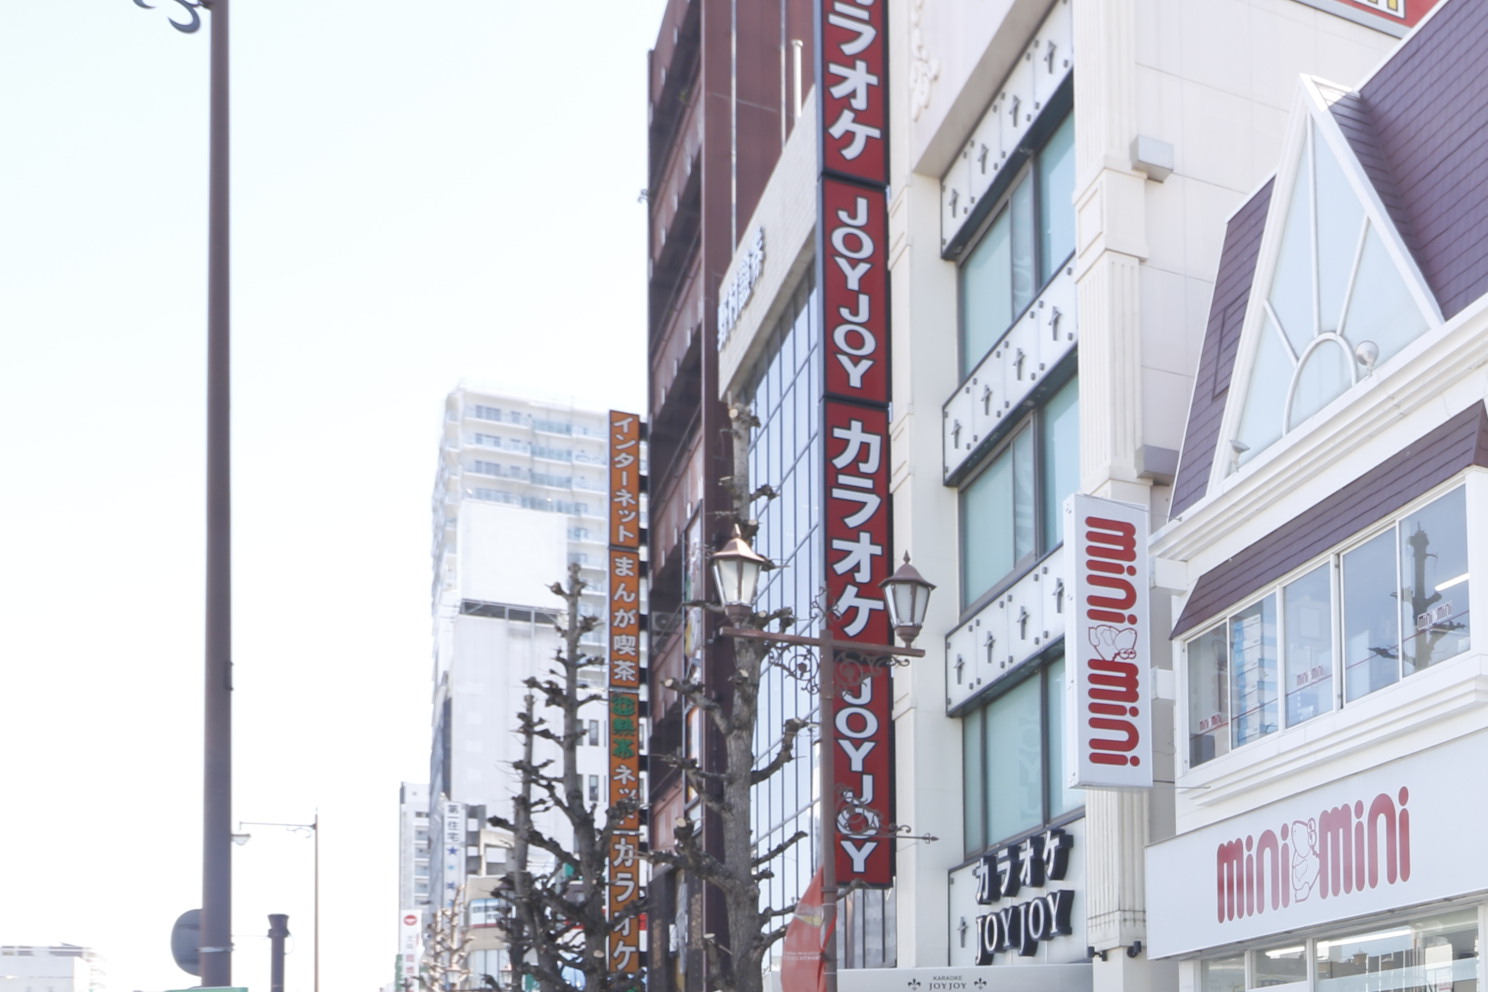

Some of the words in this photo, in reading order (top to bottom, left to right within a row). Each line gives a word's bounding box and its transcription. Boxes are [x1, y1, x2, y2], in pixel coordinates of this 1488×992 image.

[828, 0, 881, 161] ラオケ
[831, 197, 876, 388] JOYJOY
[614, 417, 636, 542] インターネット
[831, 420, 884, 637] カラオケ
[614, 556, 636, 681] まんが喫茶
[1085, 516, 1137, 625] mini
[1087, 658, 1140, 767] mini
[613, 838, 637, 971] カラオケ
[972, 829, 1073, 904] カラオケ
[1217, 823, 1290, 924] mini
[1319, 786, 1411, 900] mini
[929, 982, 967, 990] JOYJOY
[975, 889, 1074, 965] JOYJOY
